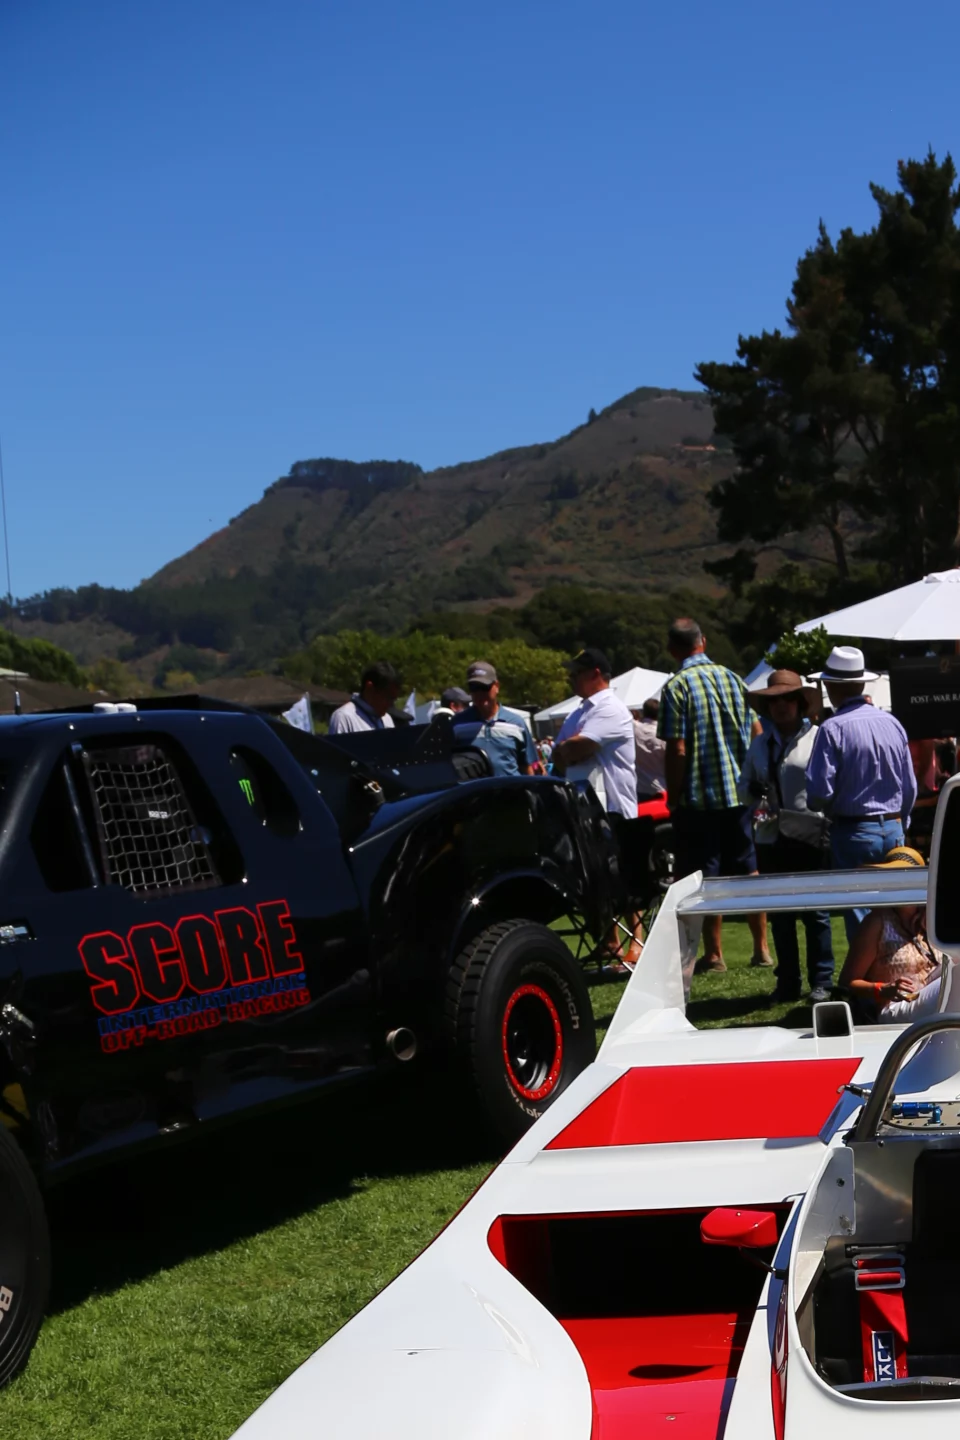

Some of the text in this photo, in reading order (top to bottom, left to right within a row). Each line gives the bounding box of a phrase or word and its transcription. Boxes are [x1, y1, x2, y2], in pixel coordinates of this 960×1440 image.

[77, 899, 305, 1016] SCORE
[97, 974, 306, 1036] INTERNATIONAL
[100, 987, 311, 1053] OFF-ROAD RACING
[876, 1337, 893, 1381] LUK
